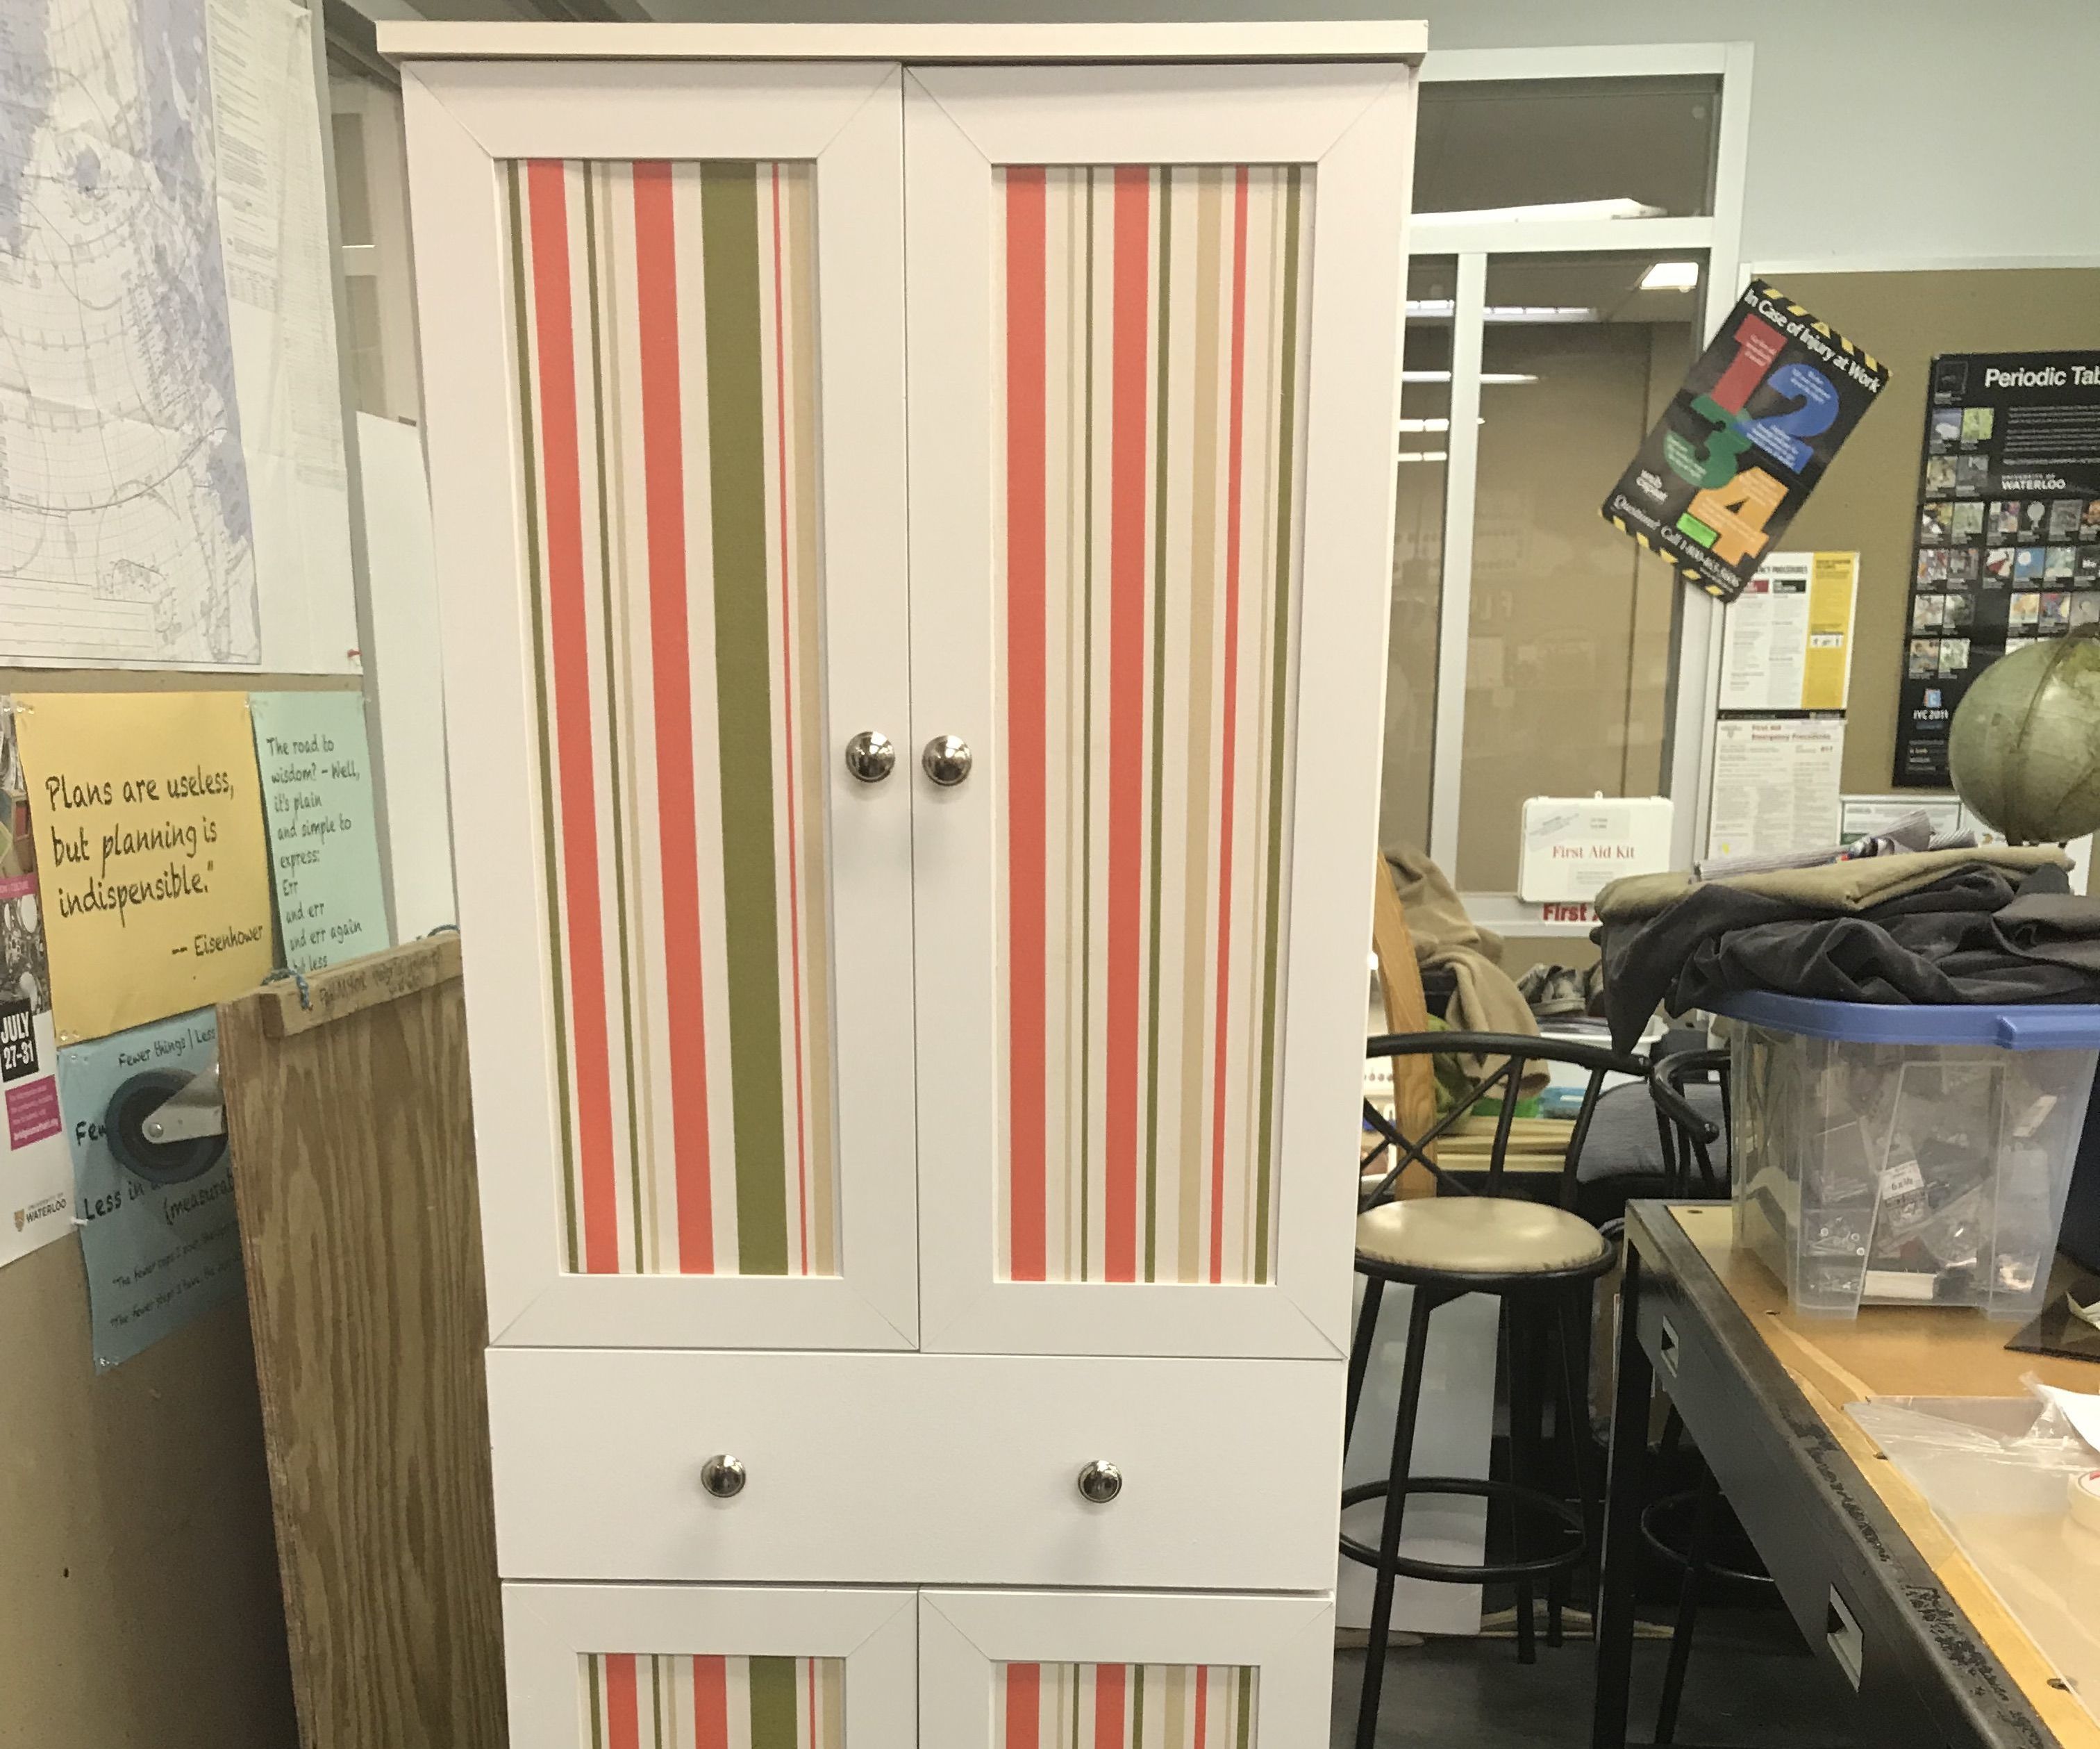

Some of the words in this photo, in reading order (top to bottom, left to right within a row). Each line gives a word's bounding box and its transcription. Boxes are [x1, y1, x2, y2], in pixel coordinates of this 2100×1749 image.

[1744, 288, 1757, 307] In
[1758, 299, 1788, 328] Case
[1787, 318, 1805, 338] of
[1800, 325, 1835, 363] Injury
[1833, 351, 1849, 371] at
[1848, 358, 1881, 394] Work
[1710, 313, 1788, 415] 1
[1984, 367, 2067, 388] Periodic
[1734, 363, 1840, 474] 2
[1663, 392, 1753, 490] 3
[2001, 479, 2066, 490] WATERLOO
[1688, 466, 1789, 566] 4
[266, 737, 289, 756] The
[292, 733, 319, 754] road
[322, 733, 334, 752] to
[272, 762, 317, 784] wisdom?
[331, 761, 360, 781] Well,
[45, 774, 112, 811] Plans
[123, 777, 160, 804] are
[167, 764, 235, 799] useless,
[274, 793, 290, 812] it's
[294, 792, 322, 820] plain
[278, 818, 297, 840] and
[301, 815, 336, 845] simple
[340, 813, 352, 831] to
[51, 825, 90, 867] but
[102, 822, 197, 879] planning
[202, 816, 217, 843] is
[1552, 845, 1583, 859] First
[1590, 845, 1611, 859] Aid
[1616, 845, 1635, 859] Kit
[281, 850, 320, 877] express:
[58, 860, 214, 928] indispensible."
[282, 879, 298, 896] Err
[286, 902, 304, 924] and
[308, 902, 325, 918] err
[1542, 904, 1588, 922] First
[194, 925, 263, 956] Eisenhower
[290, 928, 307, 951] and
[310, 929, 326, 945] err
[331, 918, 362, 944] again
[308, 955, 328, 972] less
[1, 1011, 30, 1044] JULY
[3, 1041, 35, 1070] 27-31
[118, 1049, 151, 1070] Fewer
[153, 1037, 186, 1057] things
[194, 1029, 216, 1044] Less
[26, 1198, 67, 1222] WATERLOO
[84, 1192, 122, 1220] Less
